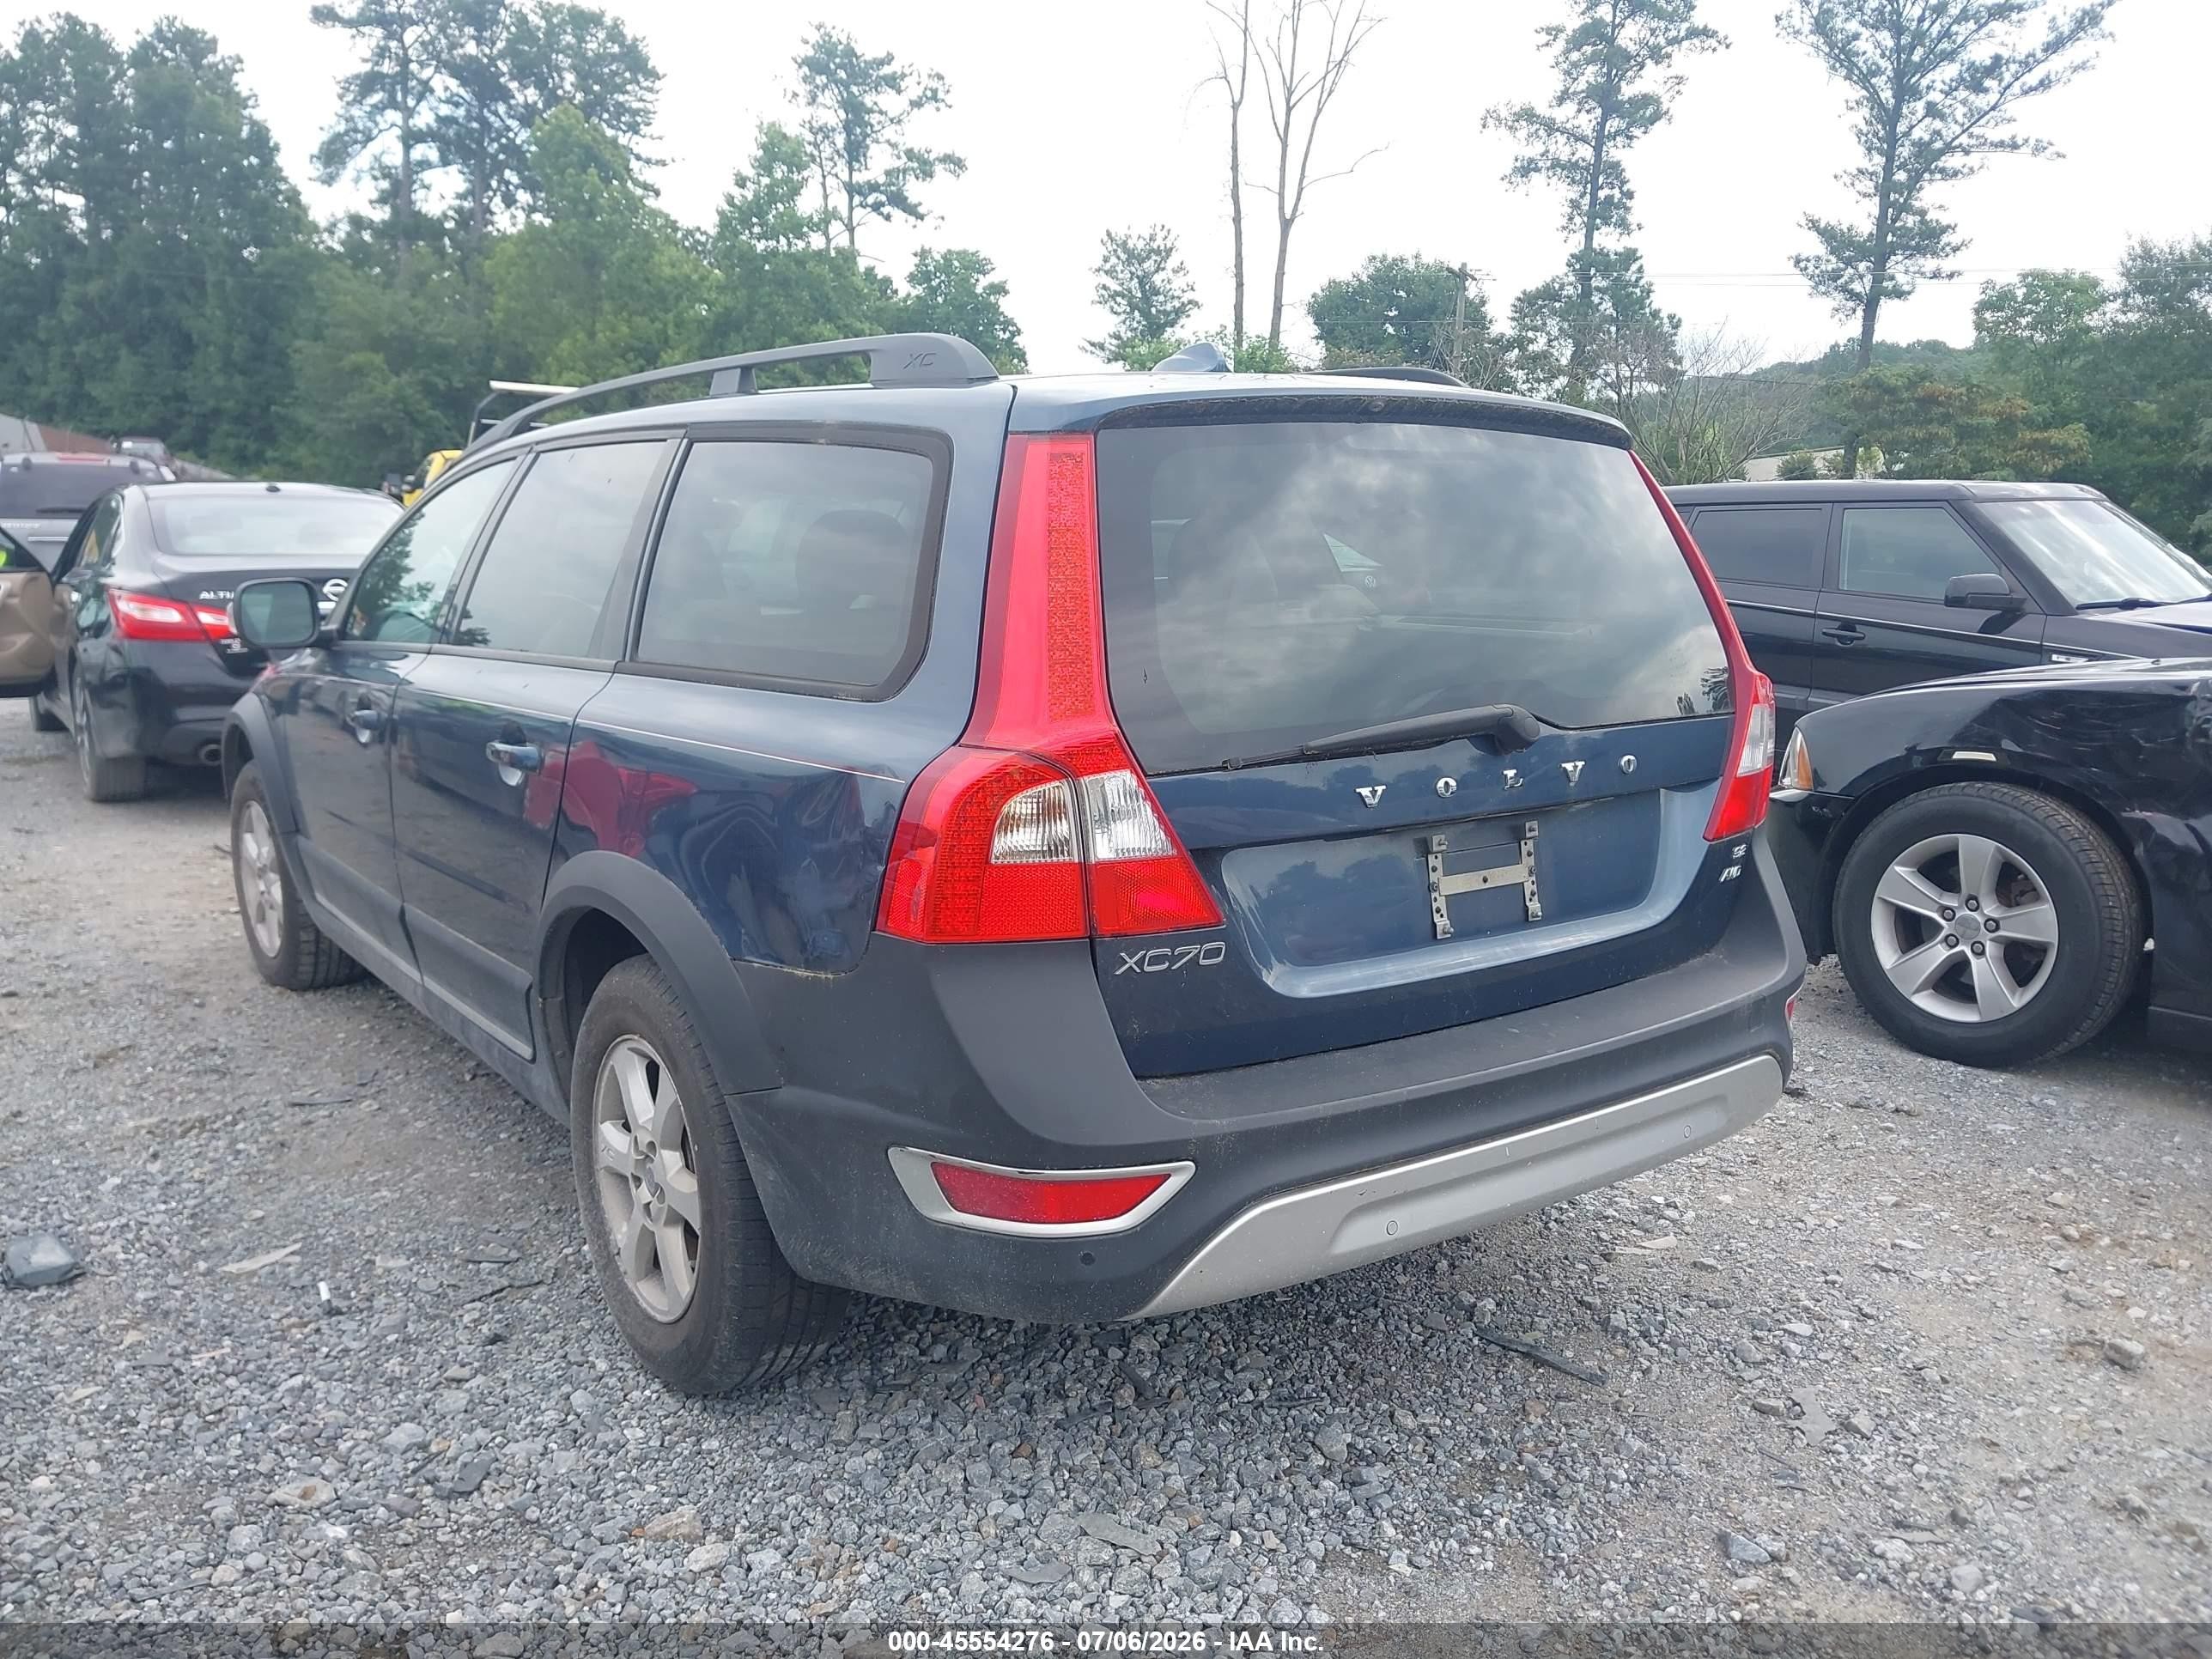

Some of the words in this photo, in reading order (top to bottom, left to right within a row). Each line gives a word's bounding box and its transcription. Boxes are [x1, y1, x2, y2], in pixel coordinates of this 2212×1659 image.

[902, 351, 937, 369] XC
[1355, 755, 1638, 808] VOLVO
[1114, 941, 1226, 975] XC70
